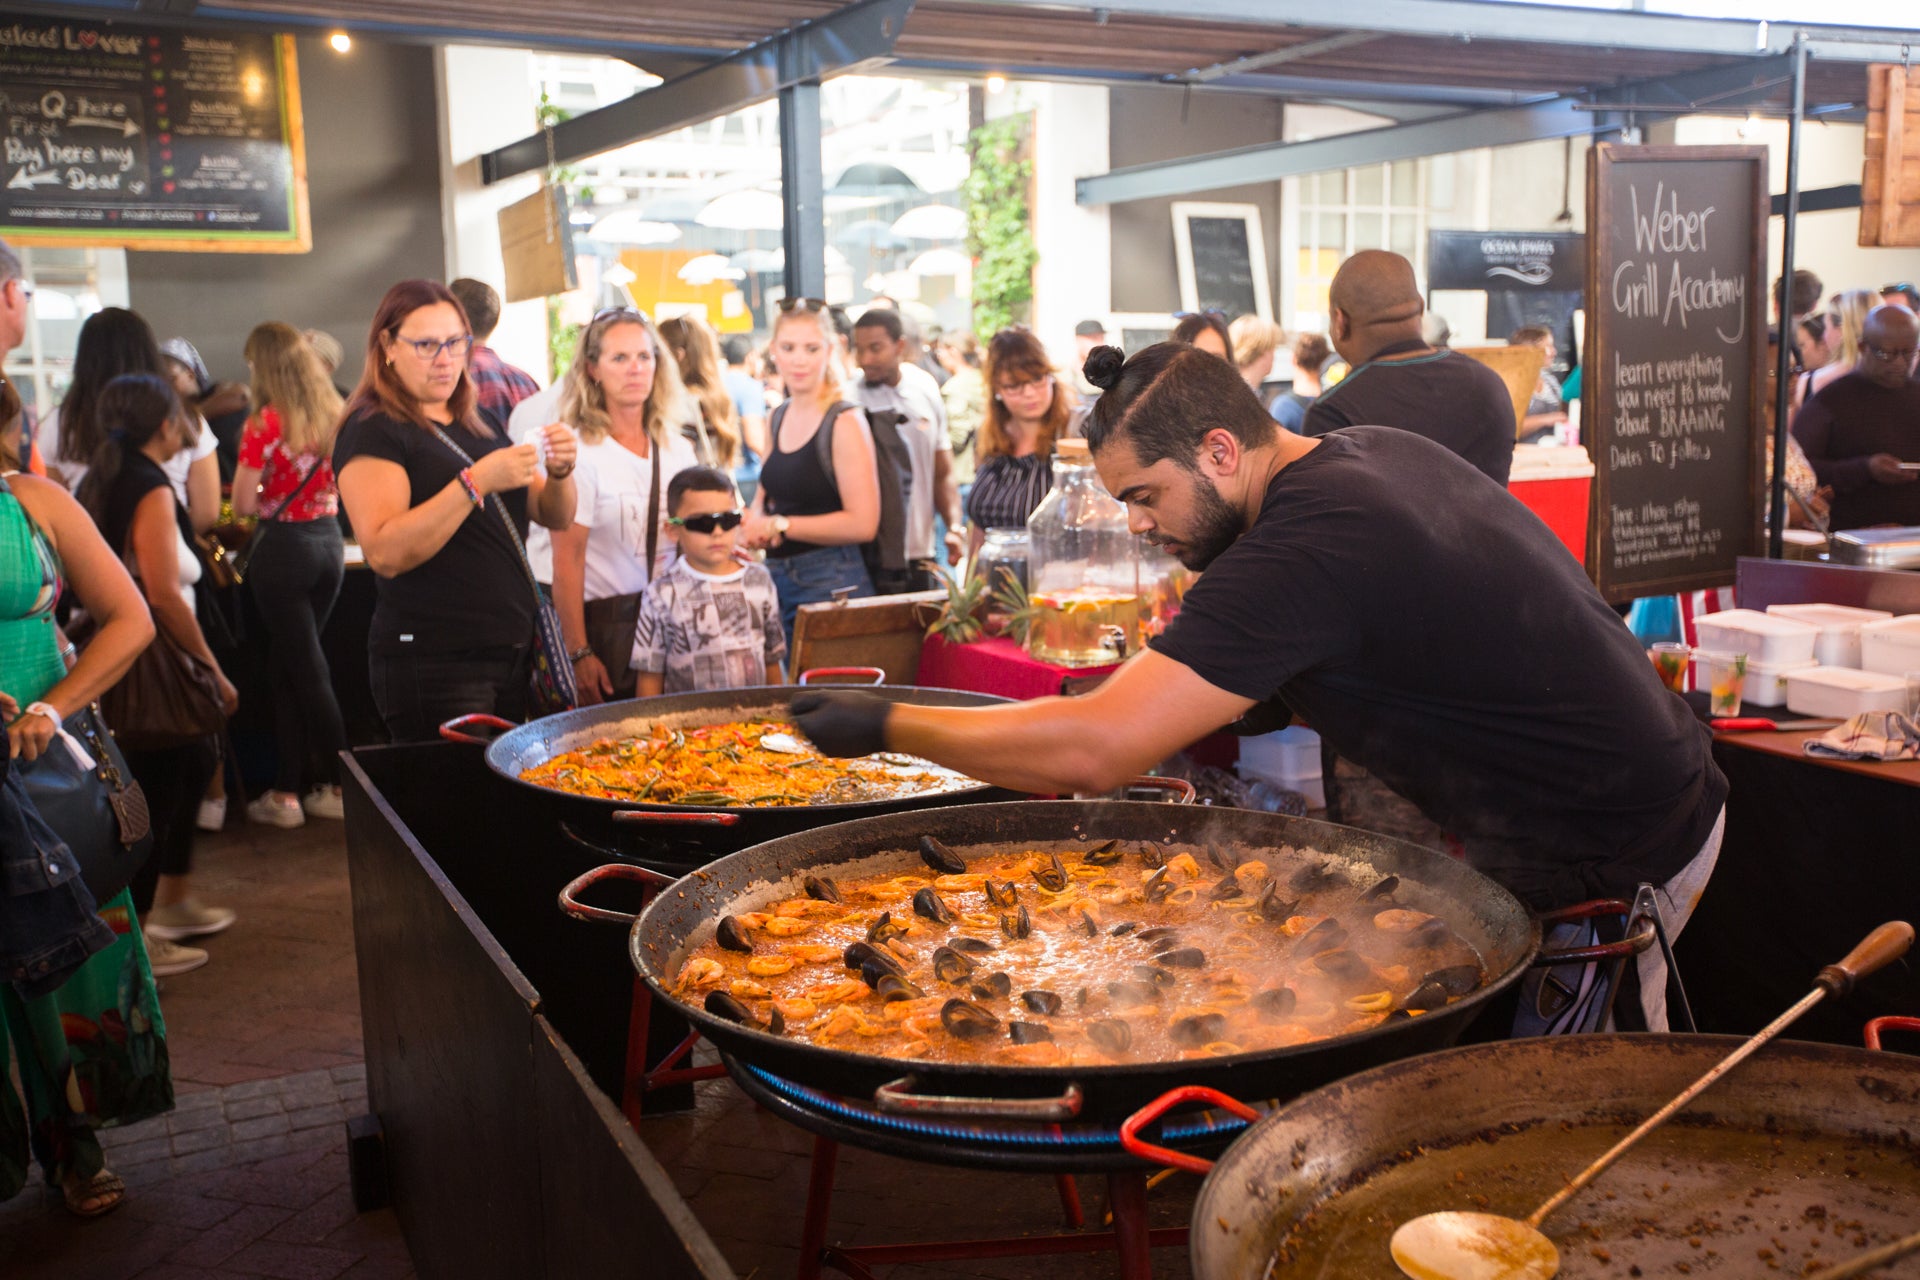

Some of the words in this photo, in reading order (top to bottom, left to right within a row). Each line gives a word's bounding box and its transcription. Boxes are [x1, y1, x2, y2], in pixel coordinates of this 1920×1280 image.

[4, 136, 44, 174] Pay
[43, 137, 96, 164] here
[101, 144, 134, 172] my
[65, 166, 120, 190] Dear
[1630, 180, 1716, 254] Weber
[1613, 260, 1659, 319] Grill
[1662, 258, 1745, 344] Academy
[1615, 350, 1653, 388] learn
[1656, 352, 1723, 387] everything
[1616, 388, 1640, 417] you
[1644, 381, 1676, 409] need
[1681, 381, 1695, 406] to
[1697, 379, 1732, 402] know
[1615, 410, 1650, 437] about
